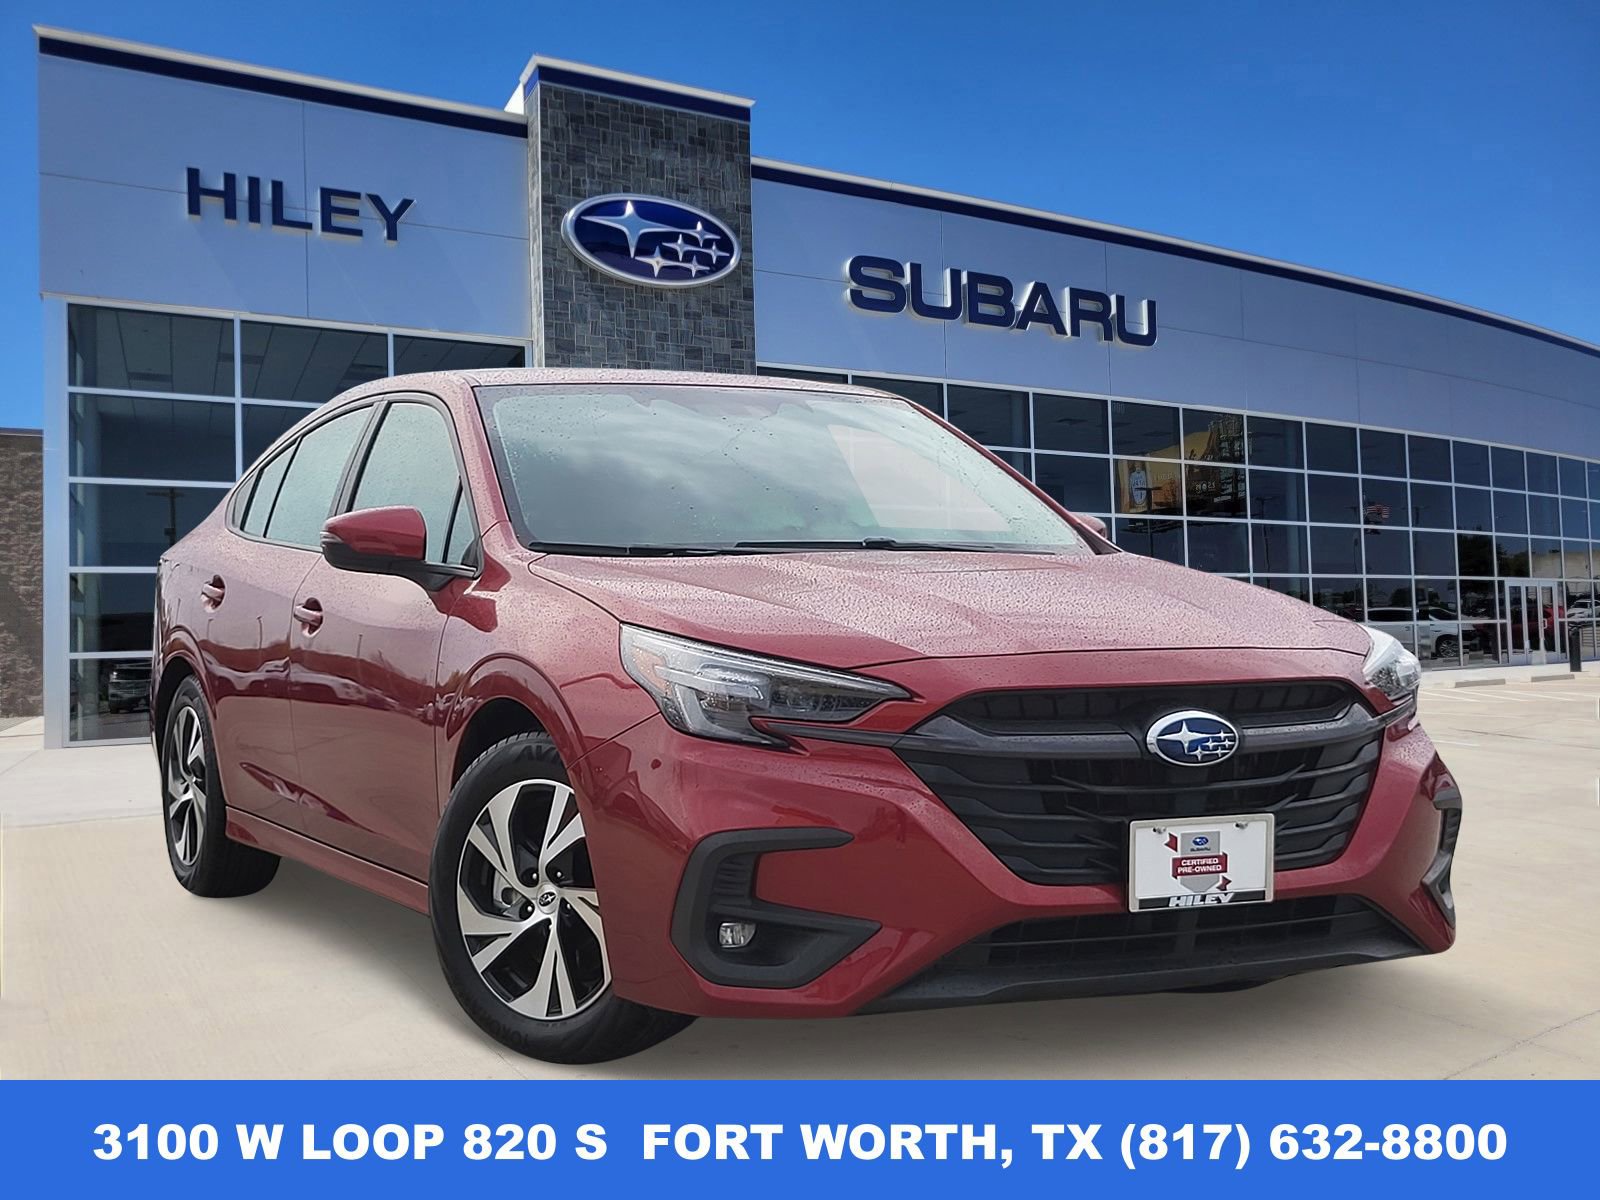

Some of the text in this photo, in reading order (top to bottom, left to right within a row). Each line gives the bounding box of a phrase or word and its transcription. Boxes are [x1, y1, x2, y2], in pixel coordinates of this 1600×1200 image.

[186, 166, 416, 242] HILEY
[847, 254, 1158, 347] SUBARU
[1177, 865, 1222, 874] PRE-OWNED
[1181, 858, 1219, 866] CERTIFIED
[1168, 892, 1234, 907] HILEY
